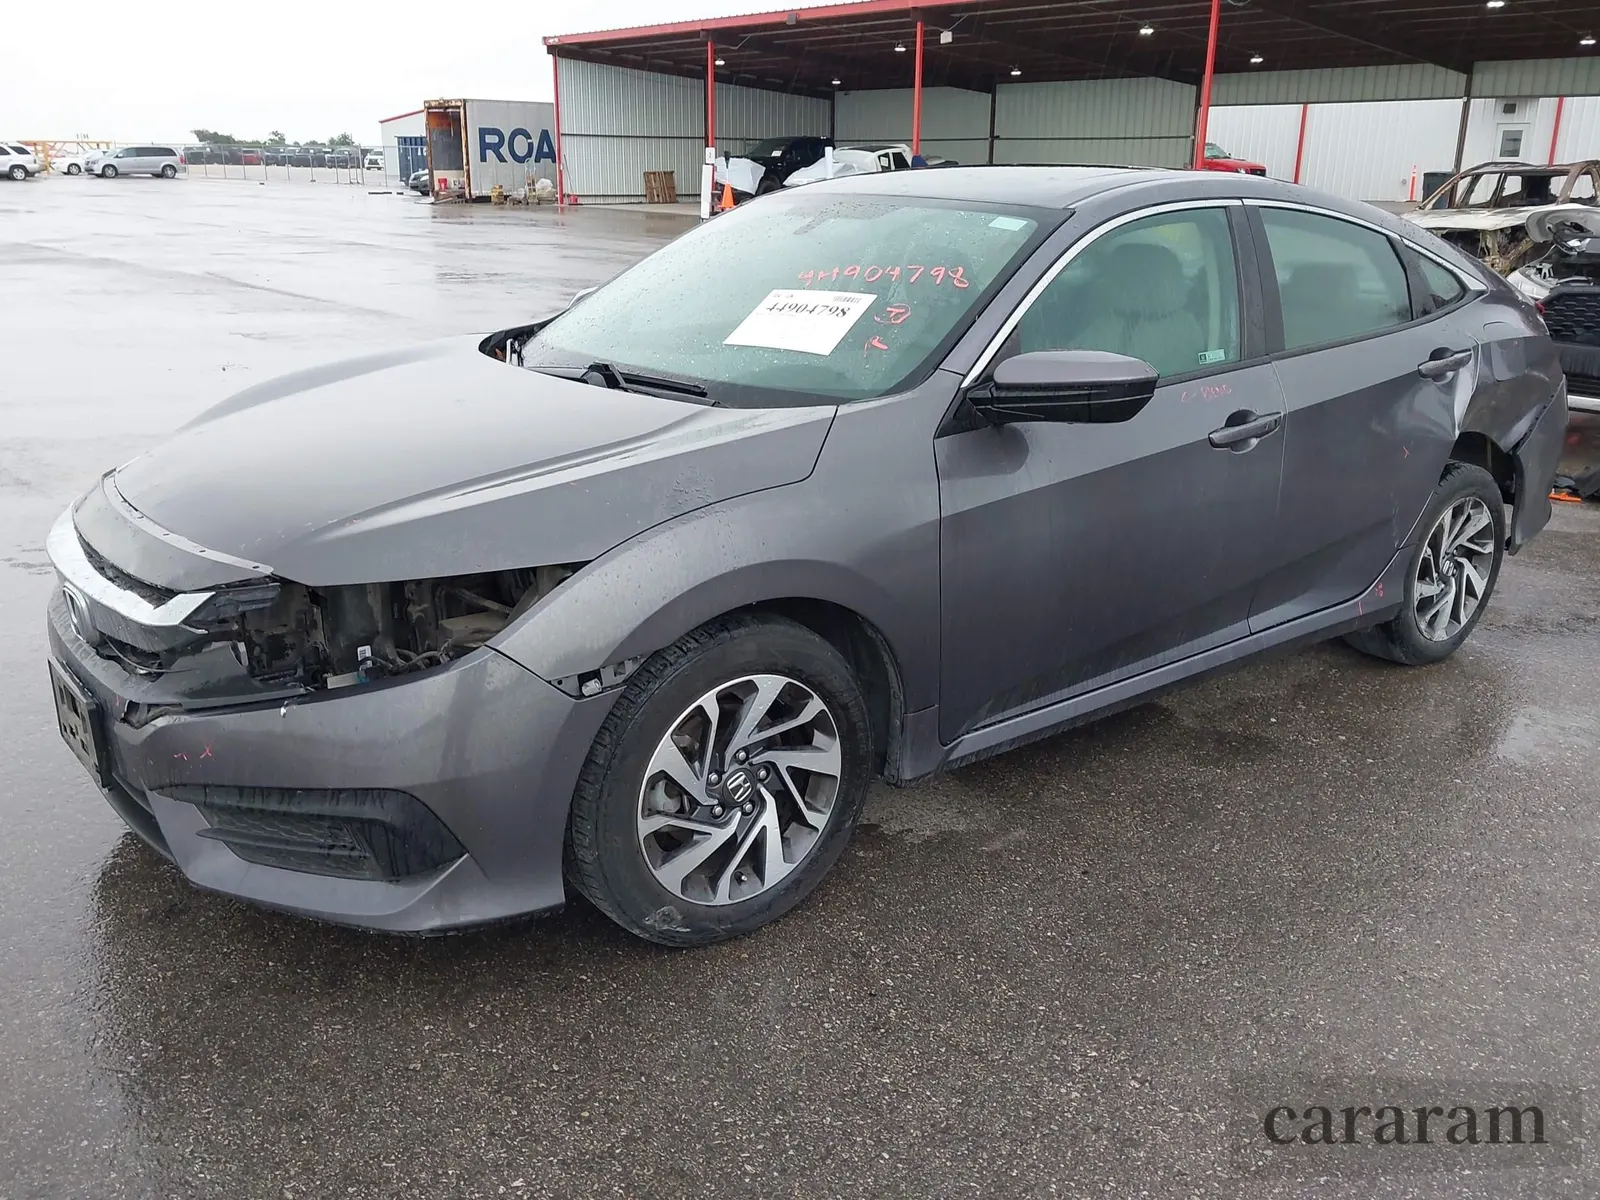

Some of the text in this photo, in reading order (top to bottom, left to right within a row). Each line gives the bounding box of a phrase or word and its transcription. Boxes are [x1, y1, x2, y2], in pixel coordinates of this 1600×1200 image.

[478, 127, 557, 164] ROA
[798, 265, 969, 288] 44904798
[767, 301, 851, 318] 44904798
